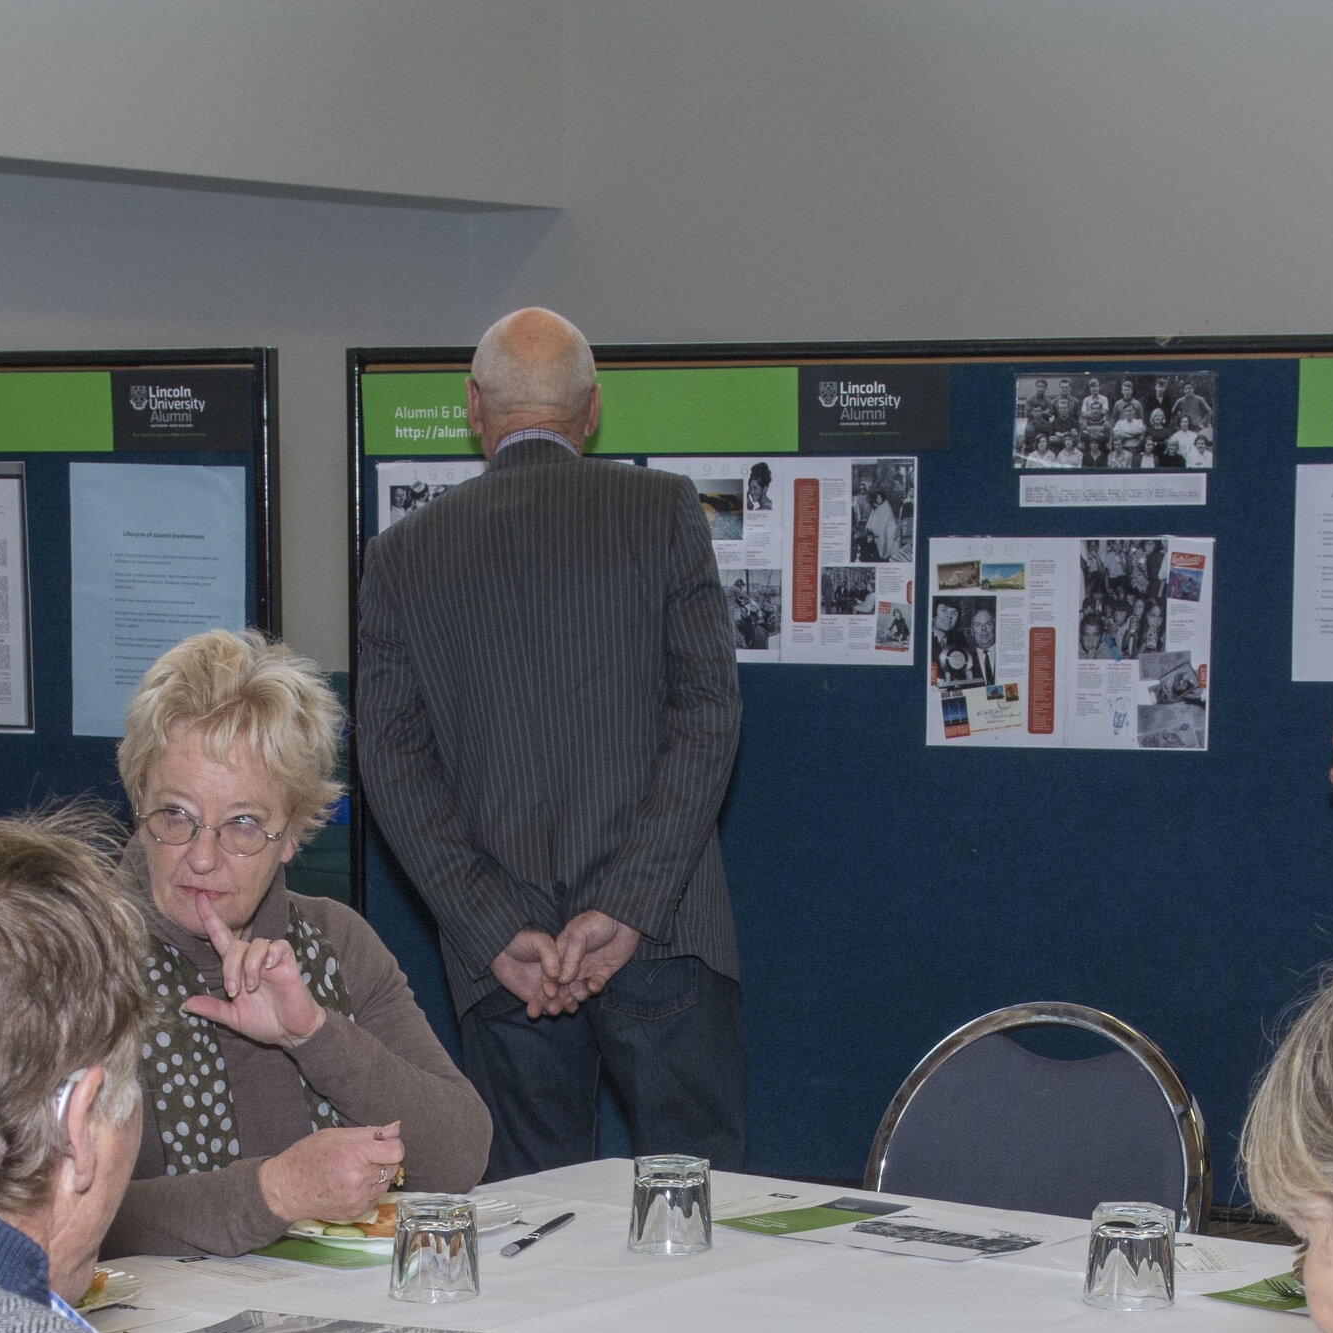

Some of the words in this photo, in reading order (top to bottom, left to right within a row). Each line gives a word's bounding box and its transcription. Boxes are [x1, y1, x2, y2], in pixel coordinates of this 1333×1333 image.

[149, 385, 191, 398] Lincoln
[840, 381, 886, 394] Lincoln
[149, 398, 205, 413] University
[840, 393, 901, 409] University
[150, 410, 192, 422] Alumni
[395, 406, 438, 418] Alumni
[441, 406, 450, 418] &
[840, 407, 886, 420] Alumni
